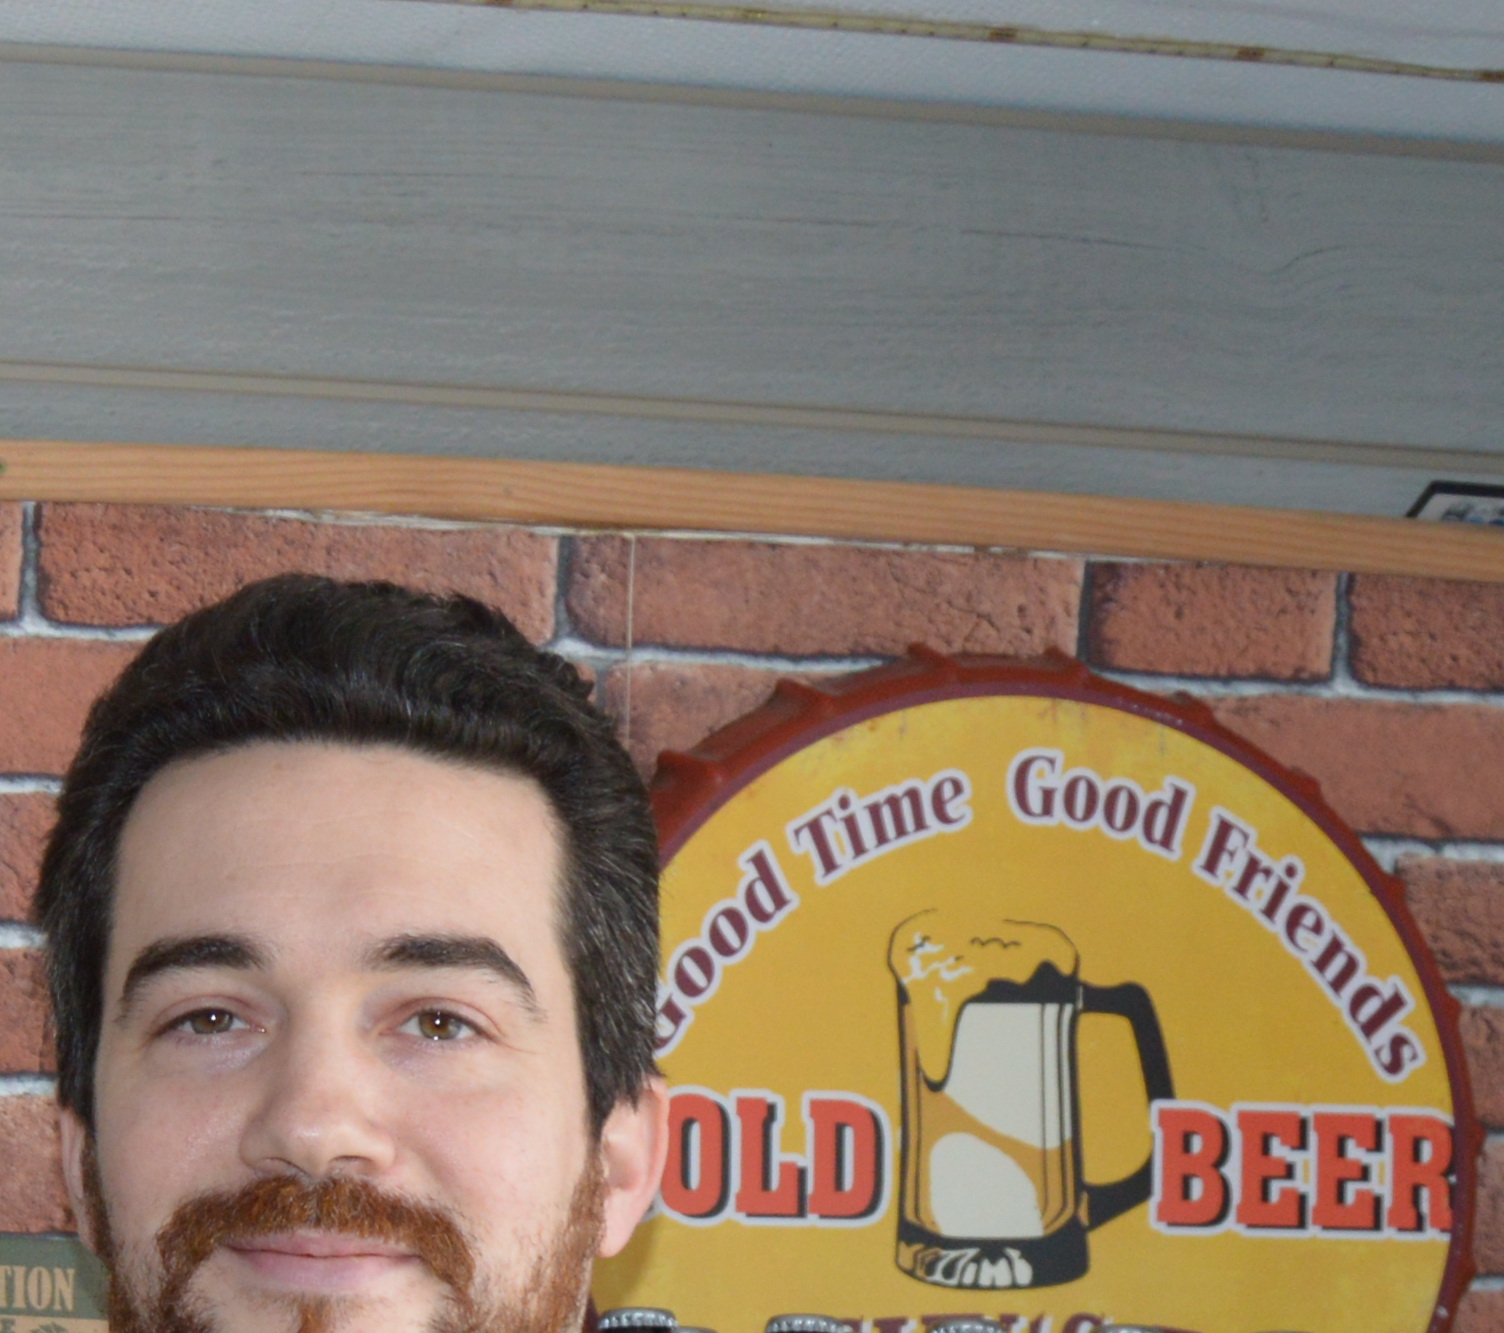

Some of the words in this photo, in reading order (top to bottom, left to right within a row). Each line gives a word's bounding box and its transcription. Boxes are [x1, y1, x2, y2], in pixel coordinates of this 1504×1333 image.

[794, 769, 969, 880] Time
[1010, 755, 1187, 853] Good
[1197, 816, 1422, 1078] Friends
[663, 1094, 881, 1219] OLD
[1156, 1107, 1456, 1233] BEER
